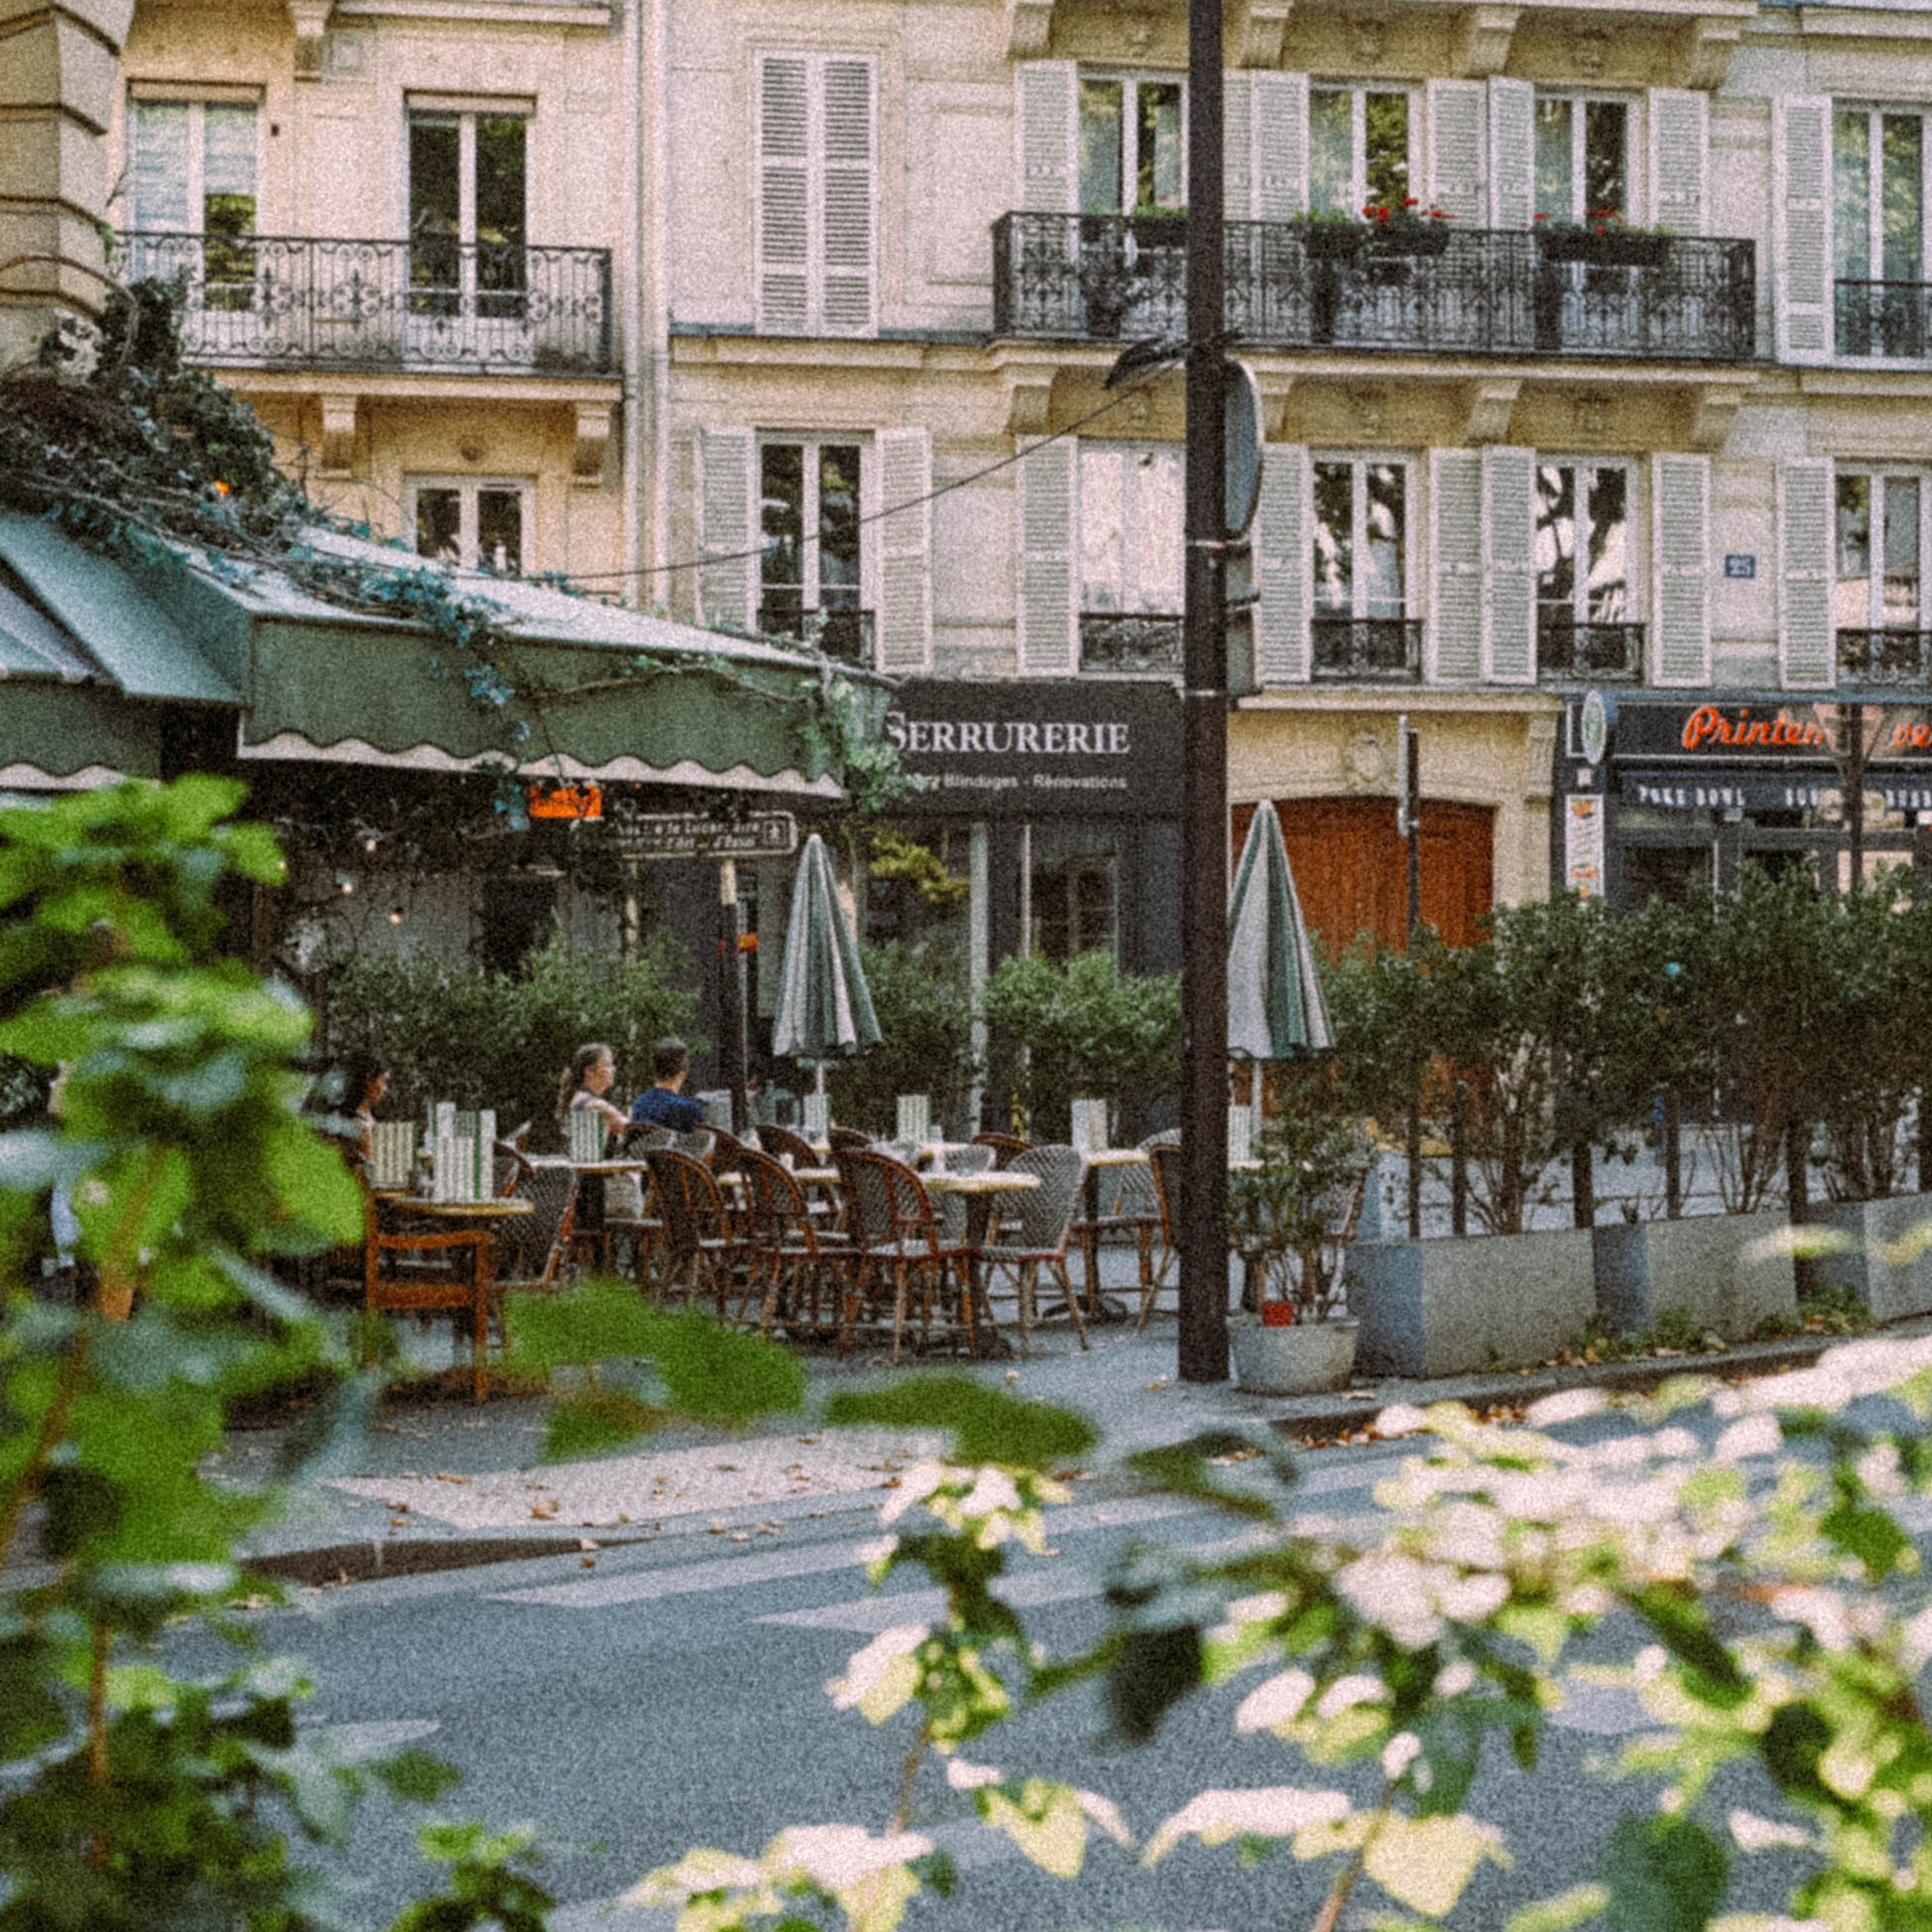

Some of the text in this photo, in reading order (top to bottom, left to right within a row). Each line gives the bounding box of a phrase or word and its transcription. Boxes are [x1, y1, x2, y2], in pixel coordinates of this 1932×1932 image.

[886, 711, 1131, 754] SERRURERIE
[1637, 785, 1746, 807] POKE BOWL
